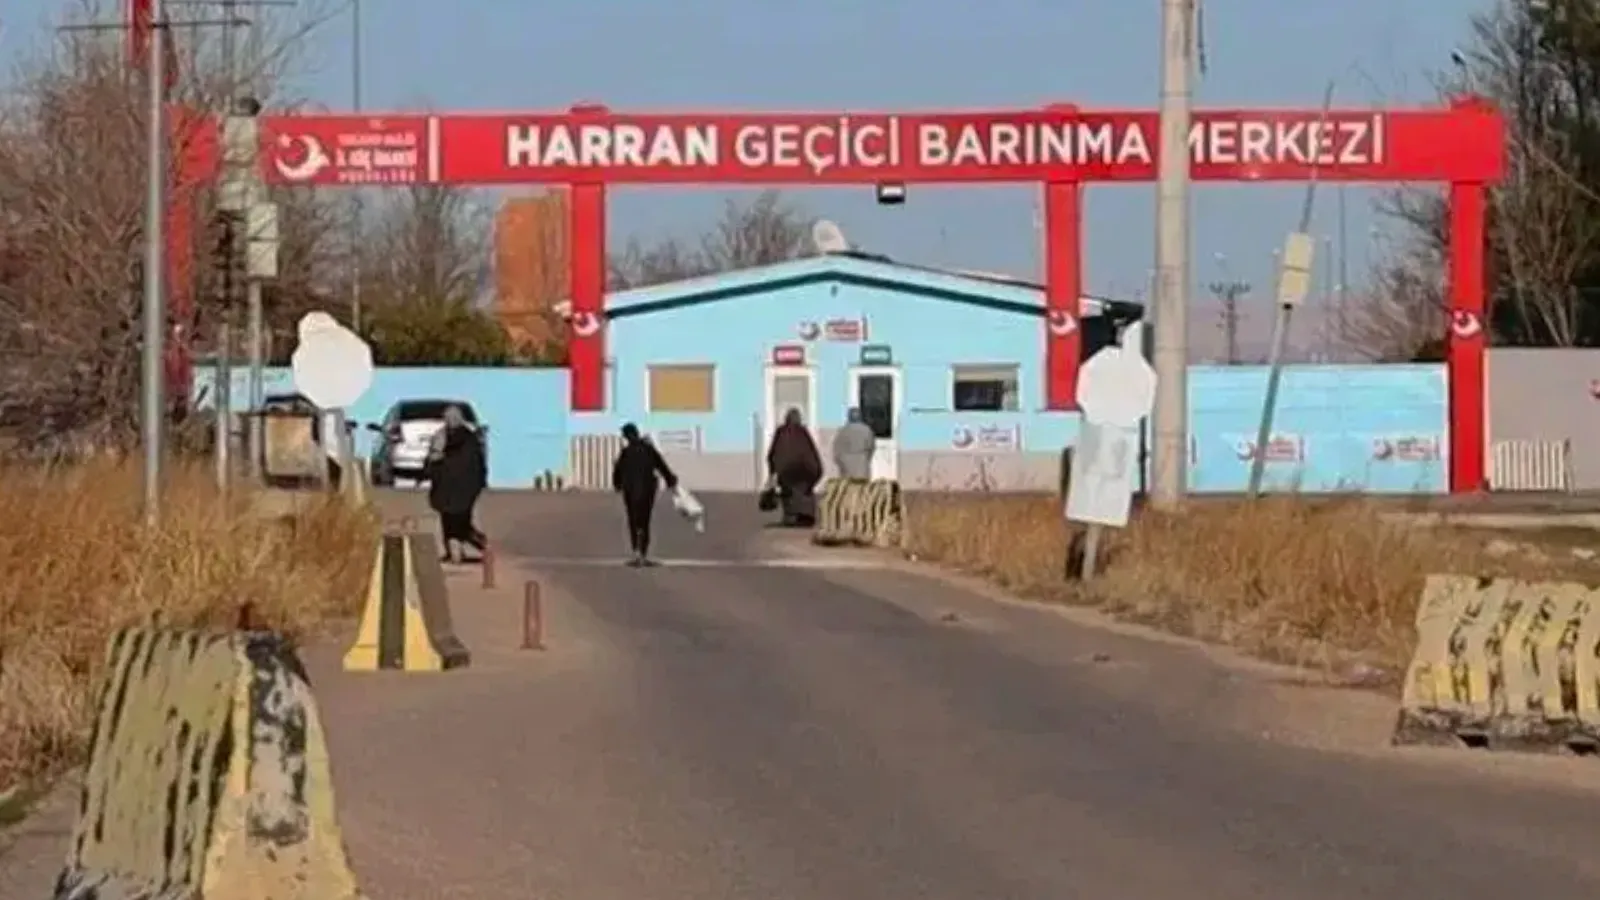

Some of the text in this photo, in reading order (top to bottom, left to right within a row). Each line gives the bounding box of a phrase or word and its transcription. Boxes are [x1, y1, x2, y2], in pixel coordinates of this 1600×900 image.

[507, 124, 719, 167] HARRAN
[735, 116, 898, 174] GEÇİCİ
[919, 123, 1150, 166] BARINMA
